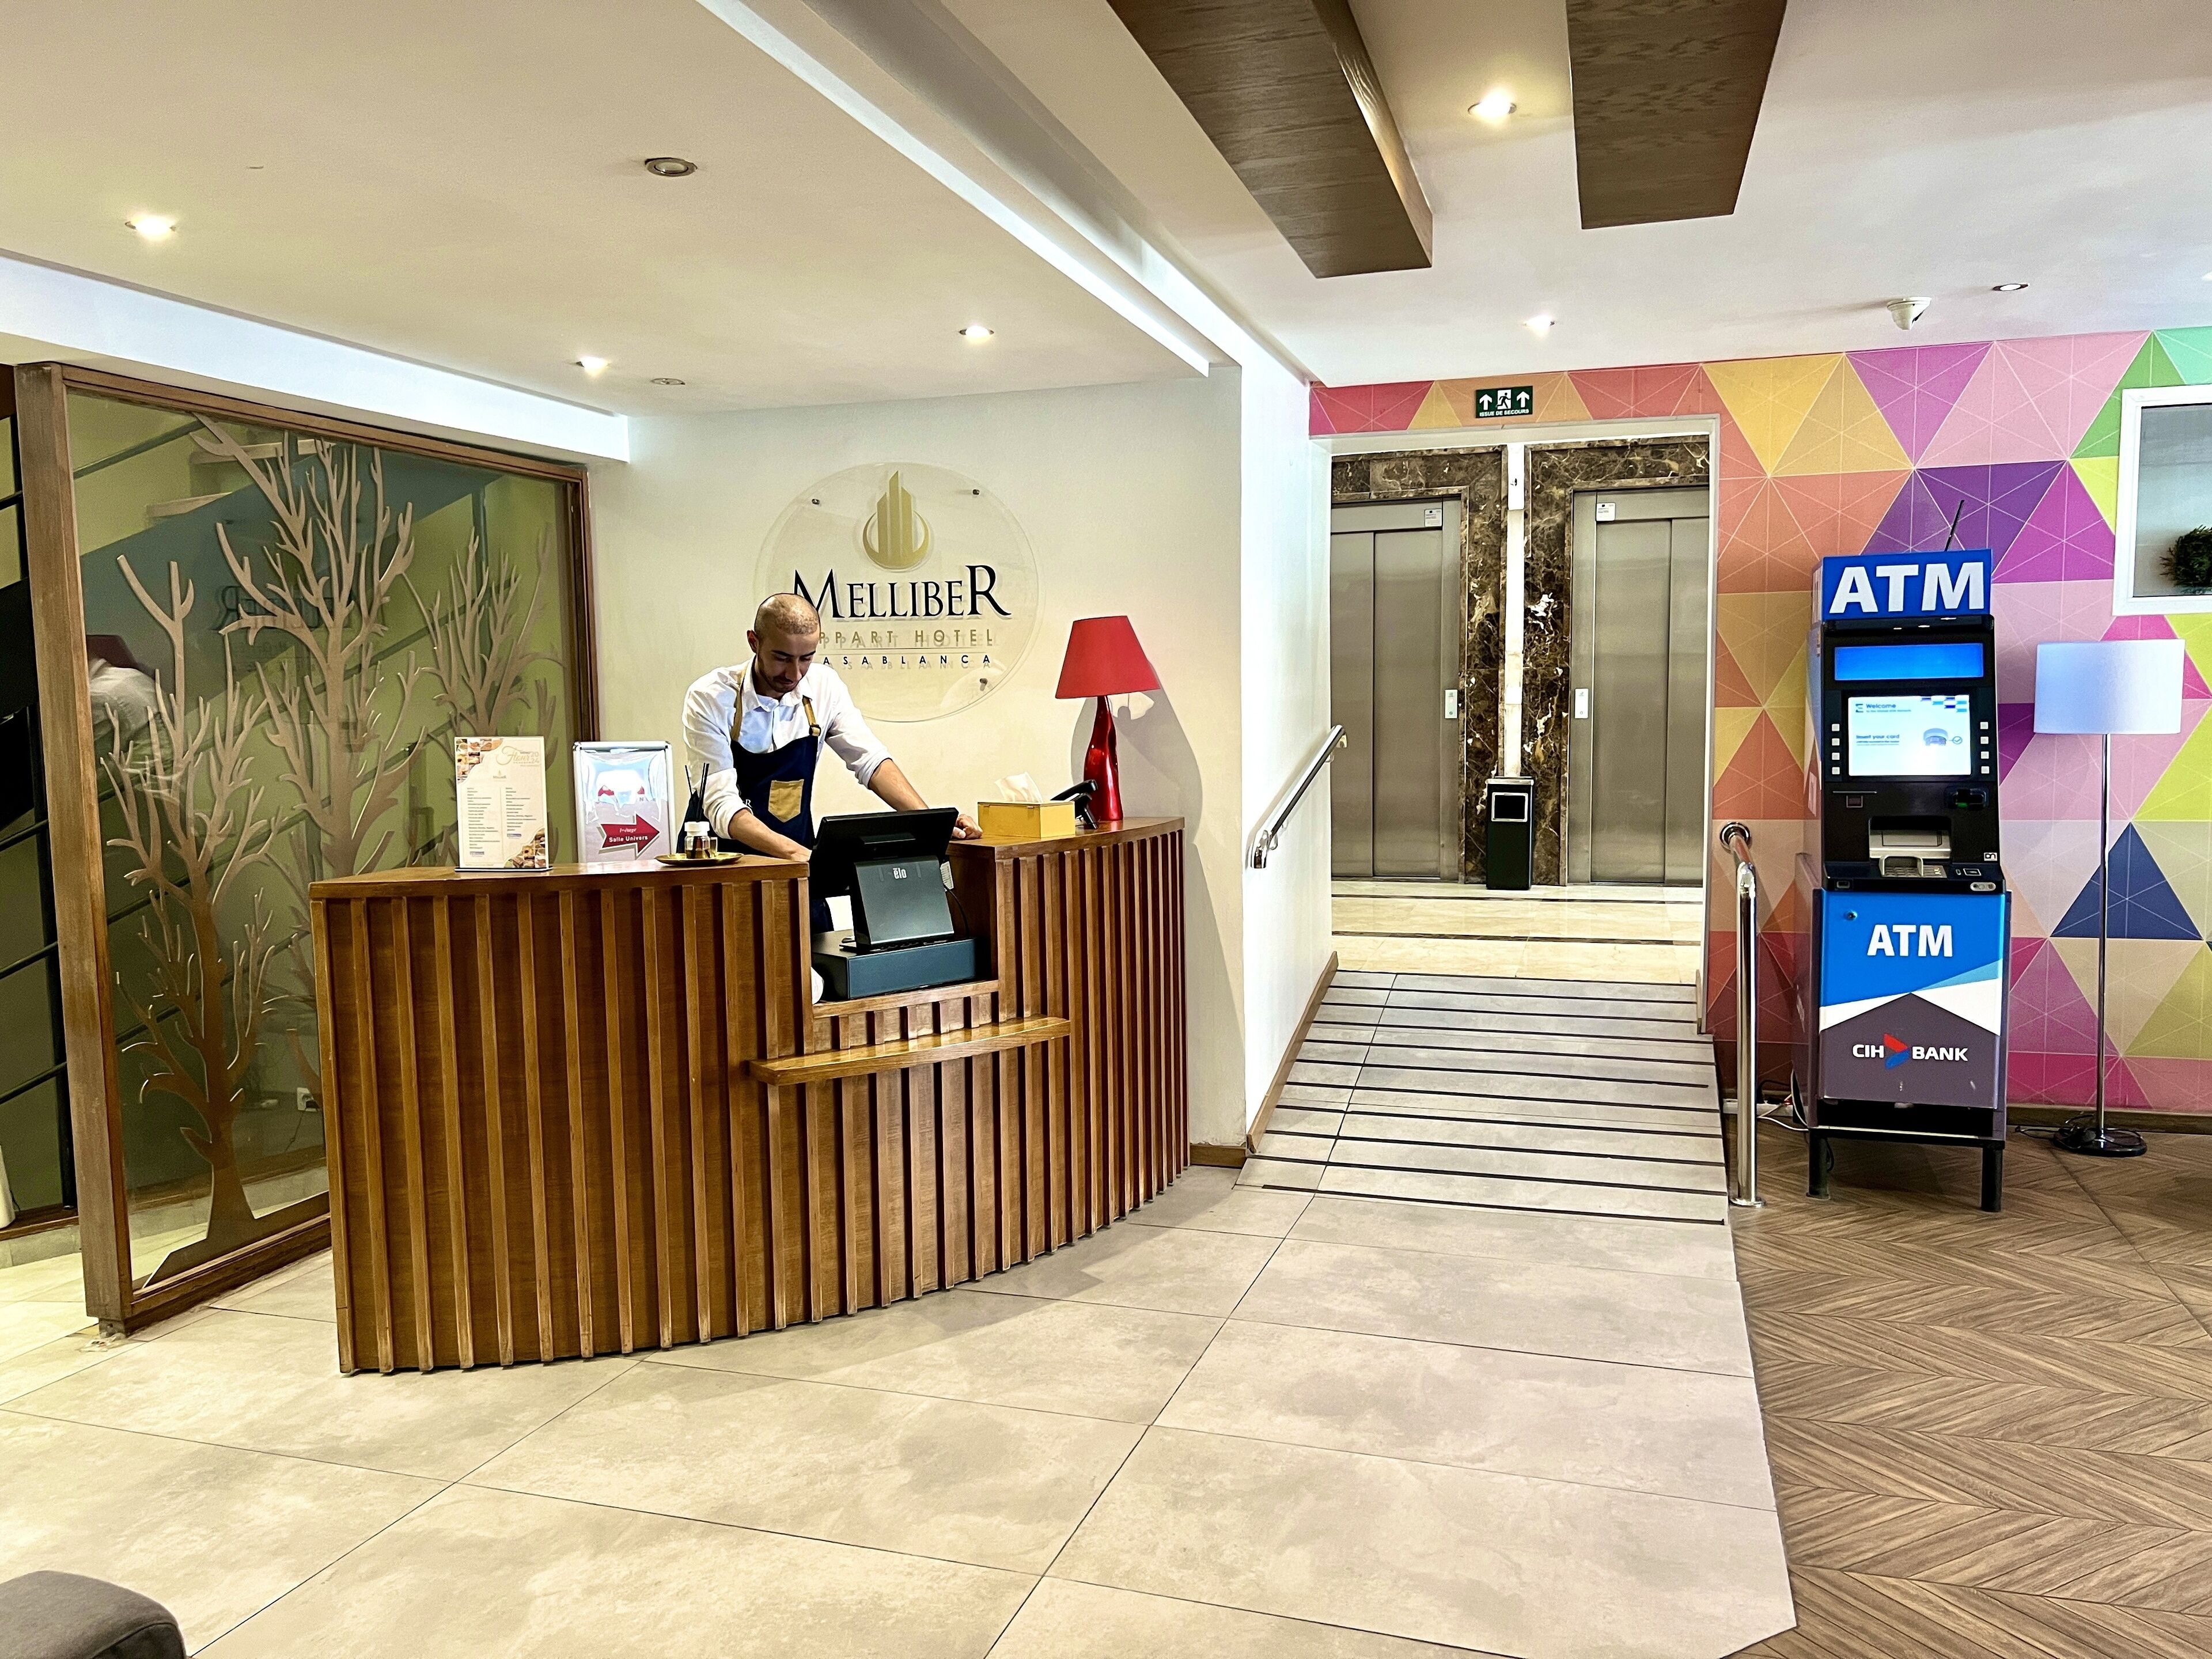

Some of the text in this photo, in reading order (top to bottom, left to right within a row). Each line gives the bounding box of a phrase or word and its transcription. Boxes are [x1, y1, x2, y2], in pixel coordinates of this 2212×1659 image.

[1829, 562, 1984, 613] ATM
[818, 628, 993, 645] PPART HOTEL
[823, 654, 990, 665] ASABLANCA
[1867, 924, 1953, 957] ATM
[1852, 1044, 1968, 1062] CIH BANK
